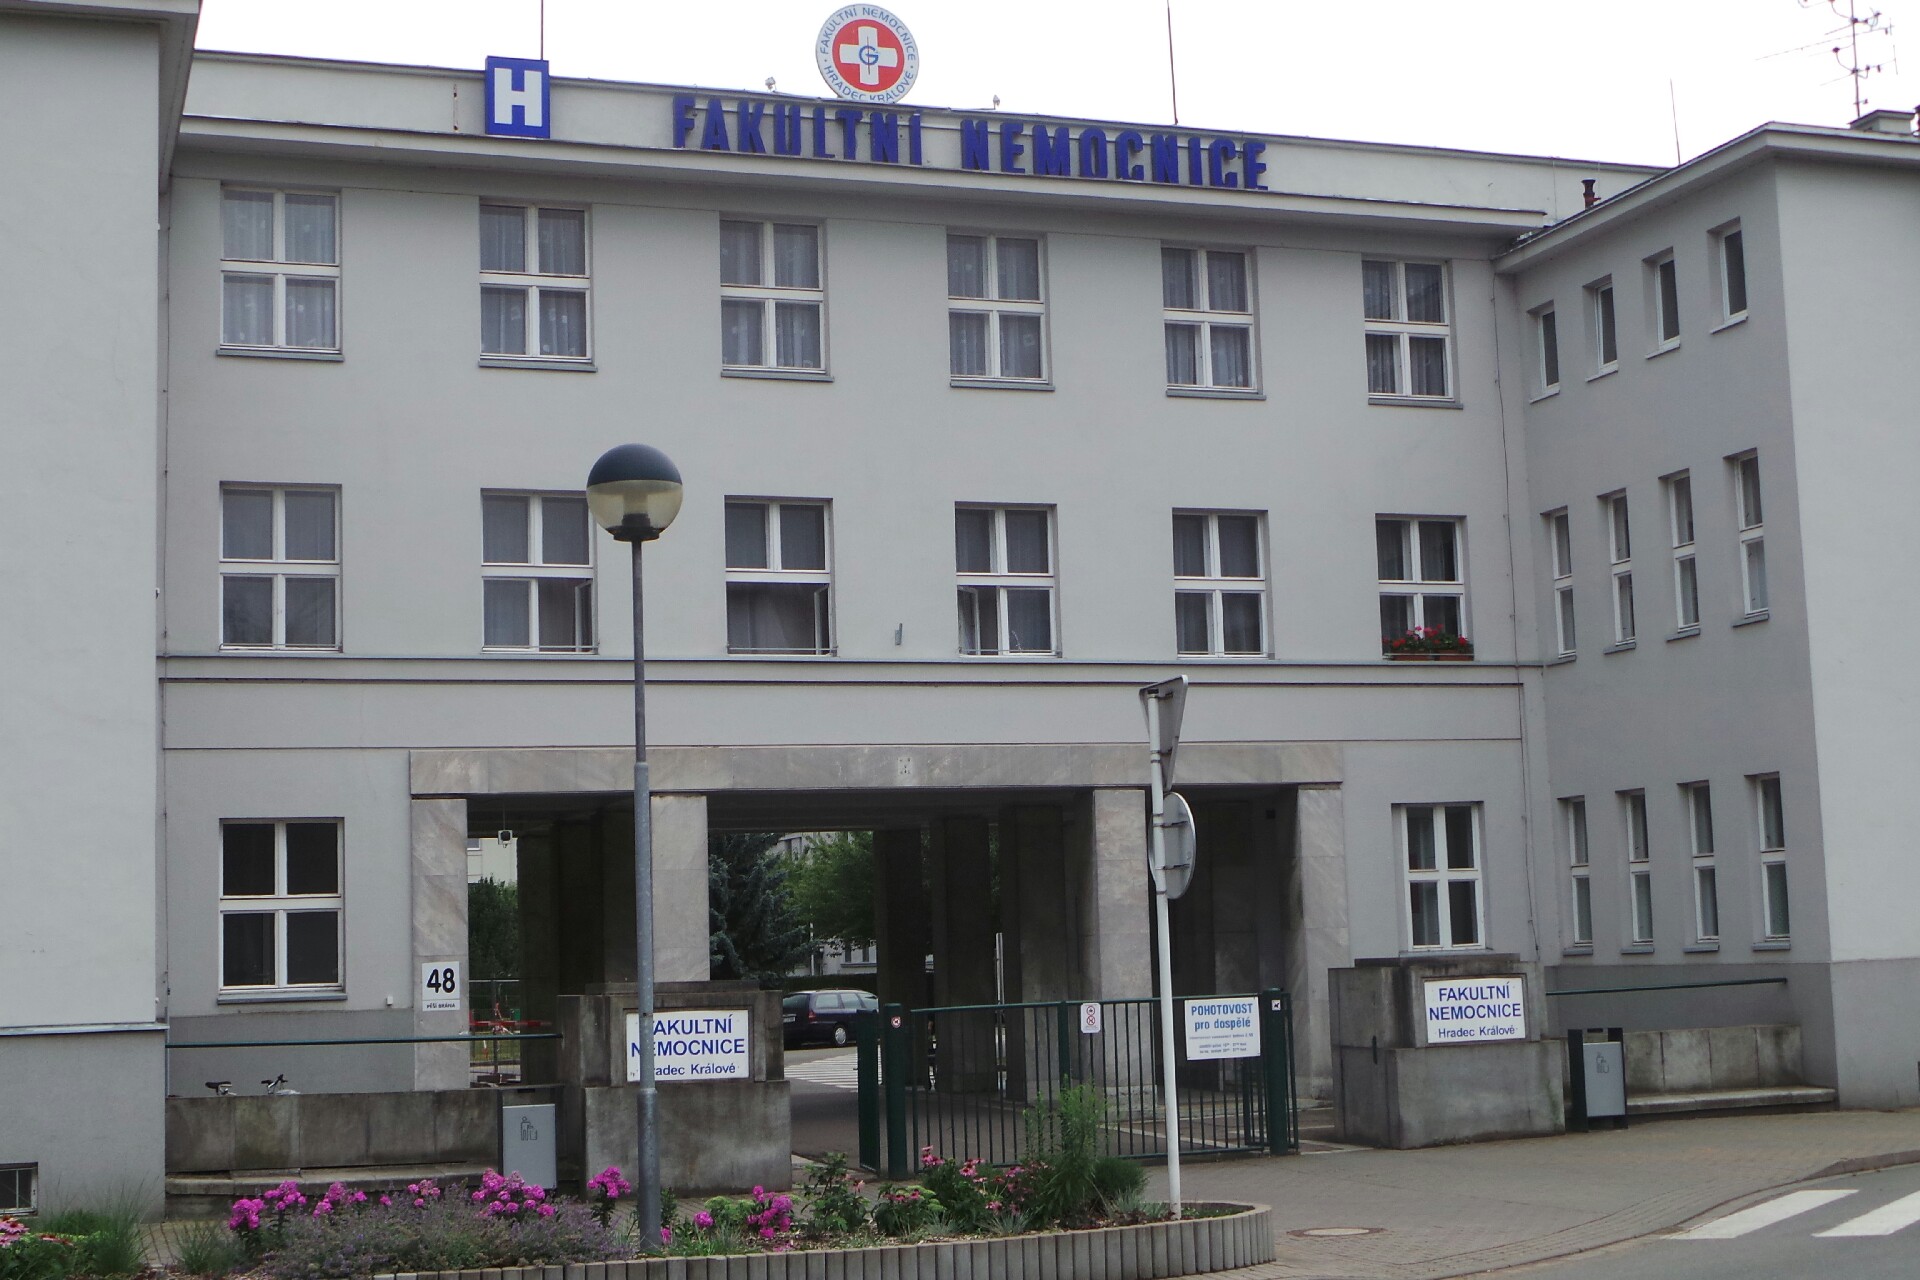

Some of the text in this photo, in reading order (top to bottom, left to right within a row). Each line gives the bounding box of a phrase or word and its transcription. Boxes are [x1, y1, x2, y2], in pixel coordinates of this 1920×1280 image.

[820, 7, 916, 61] FAKULTNÍ NEMOCNICE
[494, 67, 543, 128] H
[960, 118, 1269, 191] NEMOCNICE
[426, 967, 456, 994] 48
[1438, 981, 1510, 1002] FAKULTNÍ
[1191, 1003, 1253, 1016] POHOTOVOST
[1429, 1003, 1522, 1021] NEMOCNICE
[652, 1014, 733, 1036] AKULTNÍ
[1194, 1017, 1251, 1032] pro dospělé
[1438, 1025, 1515, 1039] Hradec Králové
[631, 1038, 745, 1057] NMOCNICE
[653, 1062, 736, 1076] adec Králové
